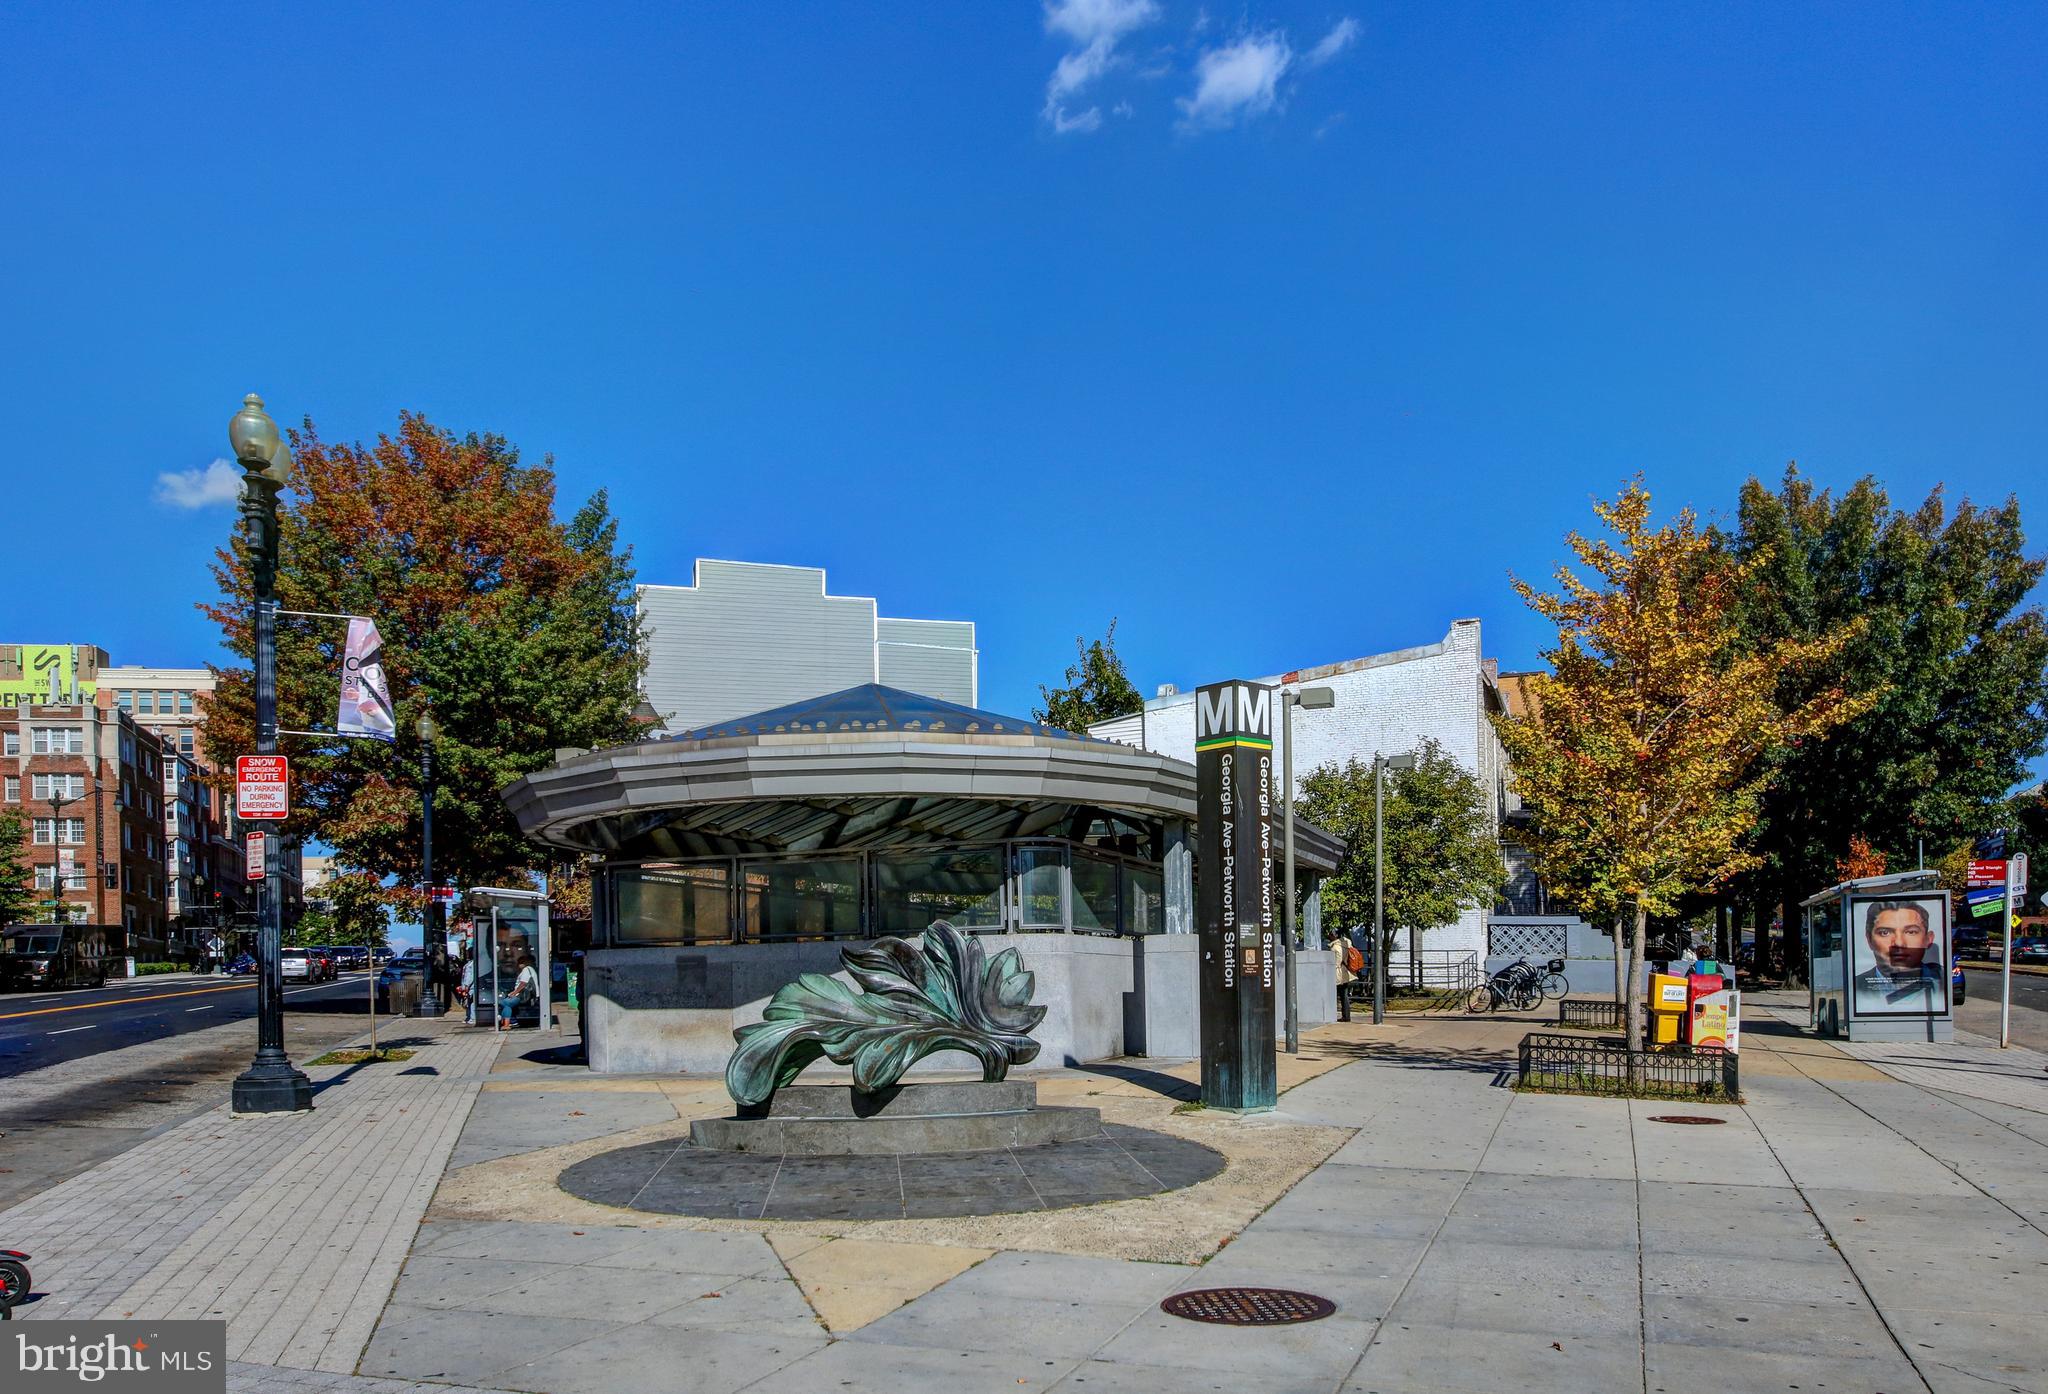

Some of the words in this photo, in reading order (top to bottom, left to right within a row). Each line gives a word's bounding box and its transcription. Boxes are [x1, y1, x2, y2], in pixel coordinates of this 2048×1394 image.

[1197, 686, 1233, 737] M
[1238, 685, 1269, 735] M
[245, 773, 279, 781] ROUTE
[248, 758, 276, 766] SNOW
[1220, 753, 1233, 816] Georgia
[1259, 756, 1270, 817] Georgia
[1224, 932, 1236, 988] Station
[1263, 932, 1273, 988] Station
